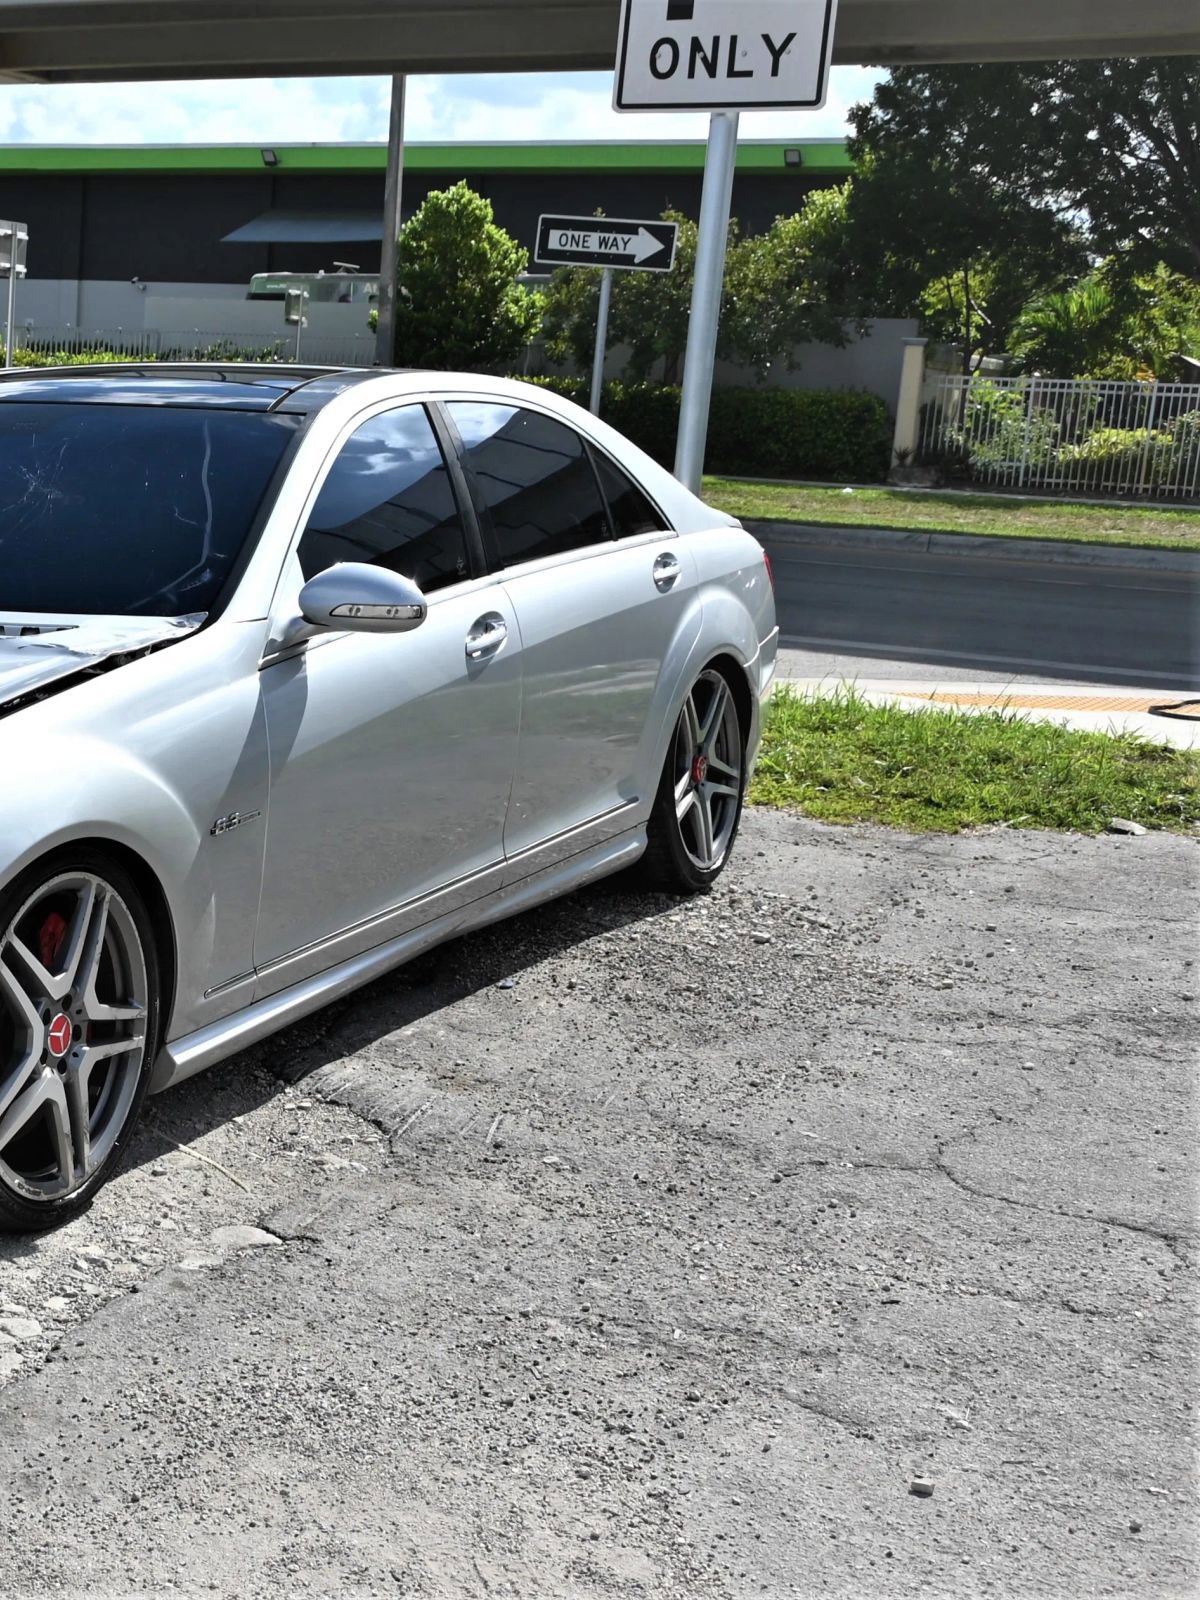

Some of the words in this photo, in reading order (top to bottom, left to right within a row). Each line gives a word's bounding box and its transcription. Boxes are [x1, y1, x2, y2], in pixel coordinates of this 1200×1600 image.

[649, 32, 797, 80] ONLY
[558, 232, 591, 249] ONE
[598, 235, 632, 251] WAY
